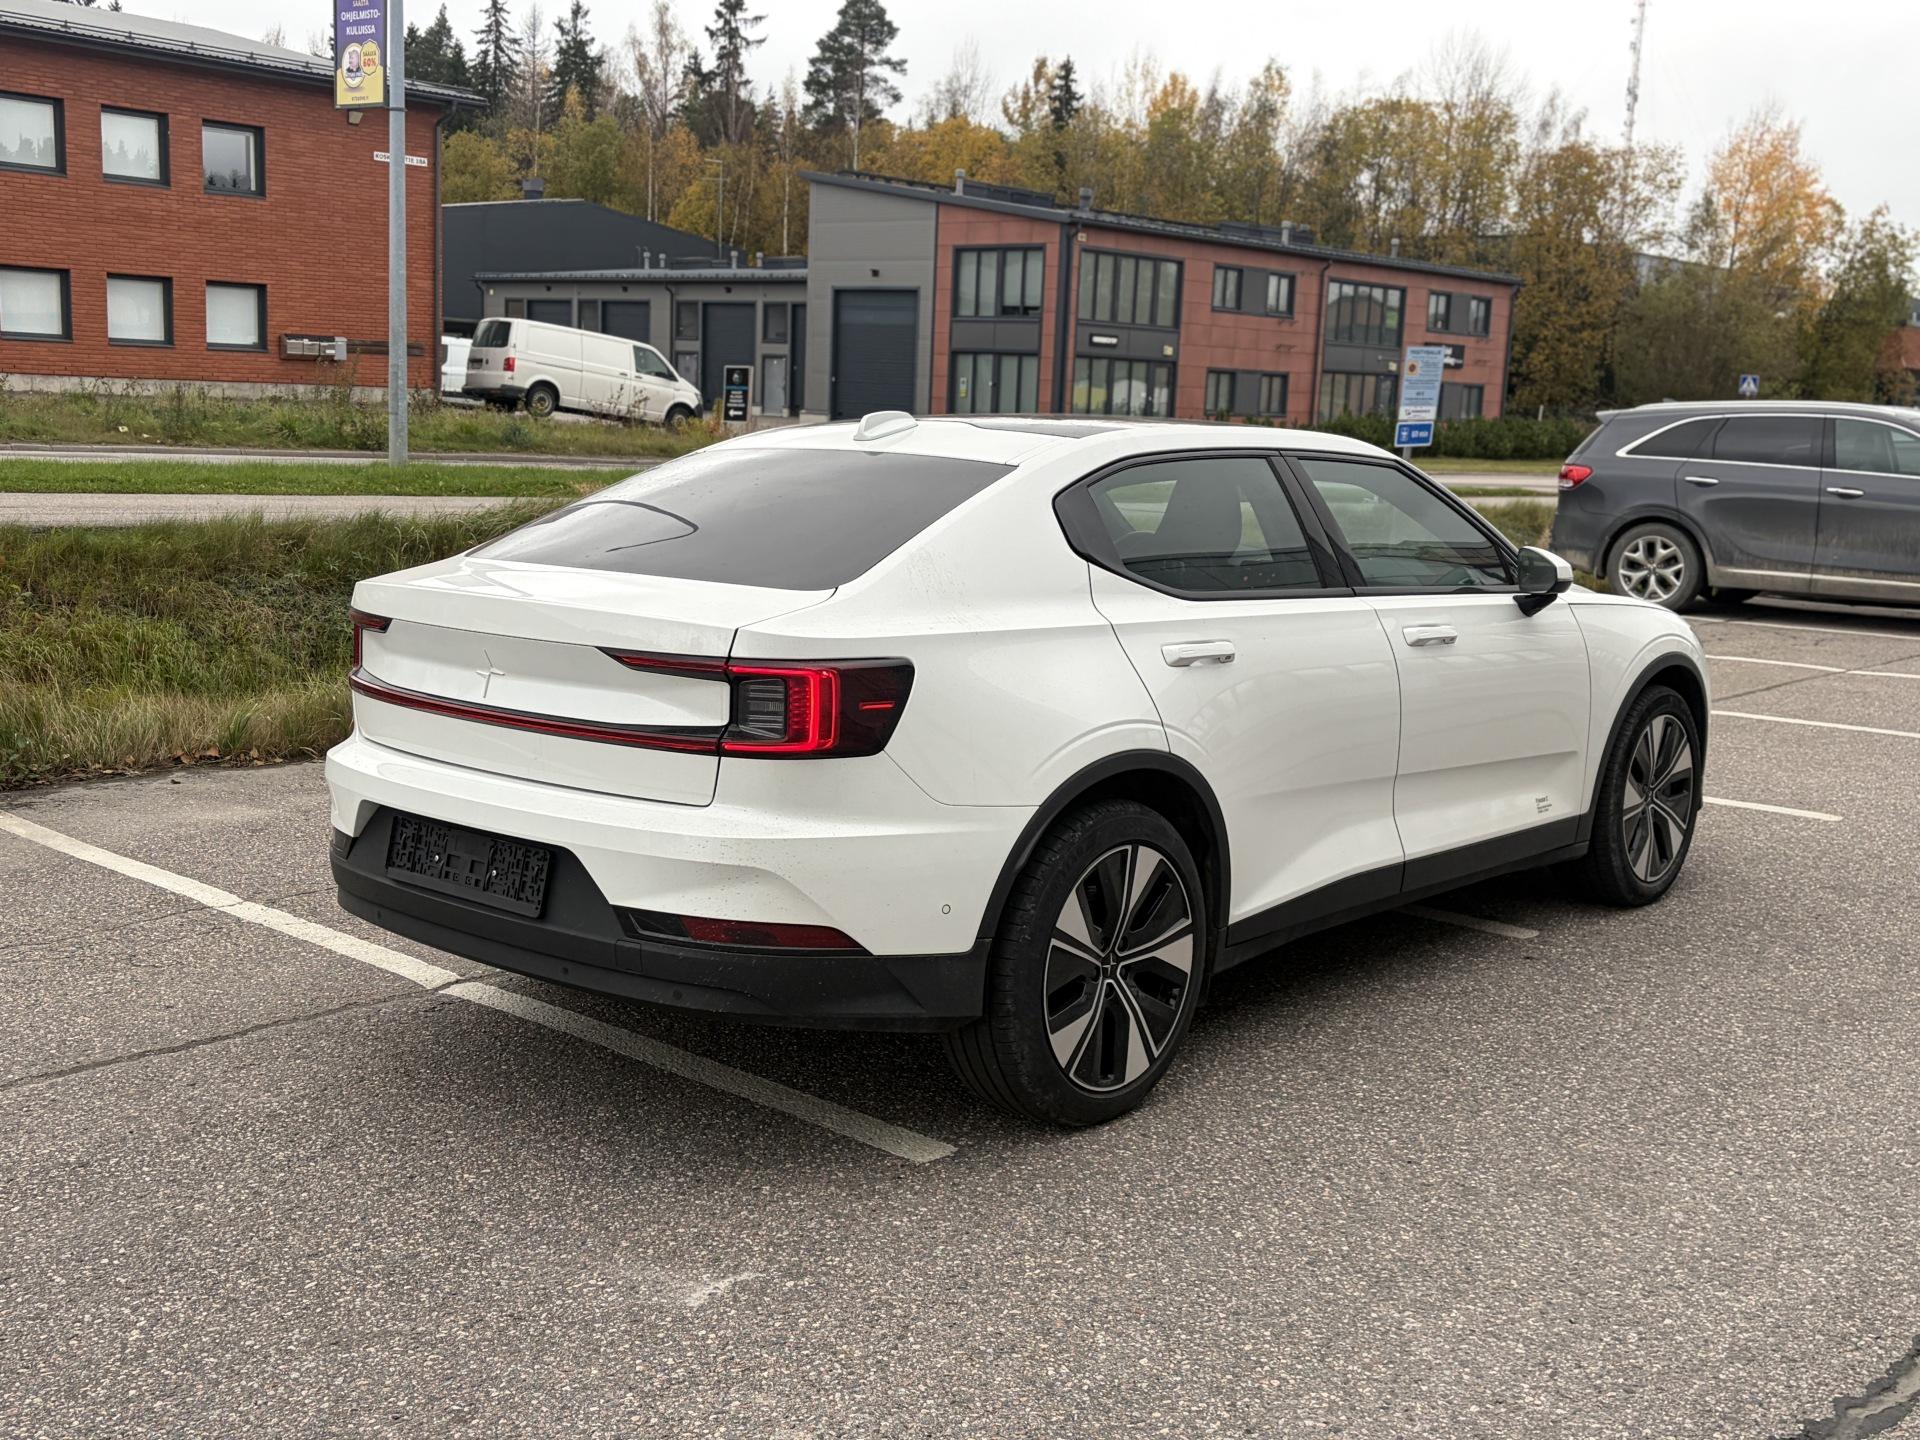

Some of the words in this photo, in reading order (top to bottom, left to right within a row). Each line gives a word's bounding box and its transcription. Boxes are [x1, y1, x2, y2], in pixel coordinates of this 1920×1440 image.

[340, 9, 381, 22] OHJELMISTO-
[346, 24, 376, 36] KULUISSA
[363, 58, 377, 67] 60%
